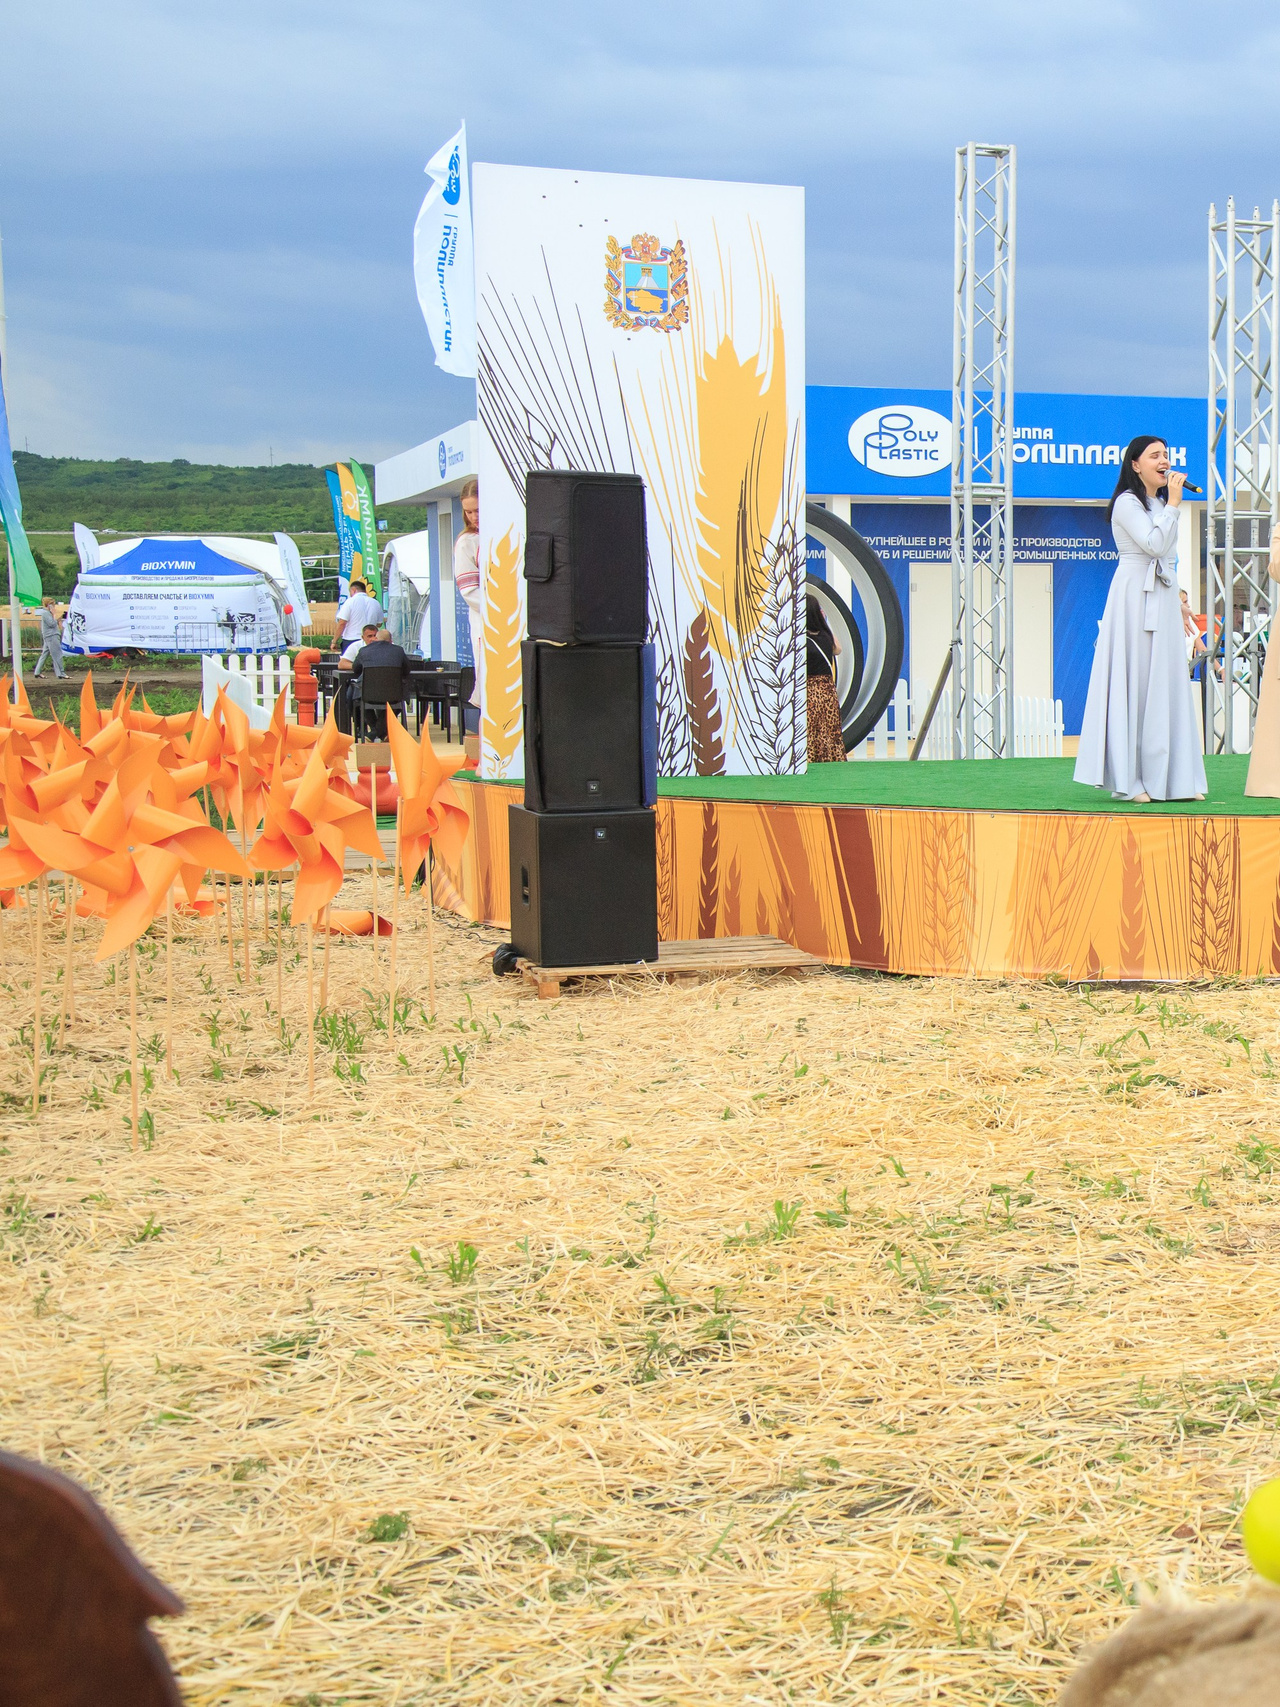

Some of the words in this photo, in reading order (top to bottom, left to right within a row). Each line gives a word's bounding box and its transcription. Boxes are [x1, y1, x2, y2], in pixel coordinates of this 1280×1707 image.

[448, 226, 458, 267] ГРУППА
[878, 413, 939, 442] POLY
[862, 535, 927, 546] РУПНЕЙШЕЕ
[929, 537, 936, 546] В
[1021, 538, 1102, 548] ПРОИЗВОДСТВО
[892, 550, 900, 559] И
[902, 548, 953, 559] РЕШЕНИЙ
[141, 561, 196, 571] BIOXYMIN
